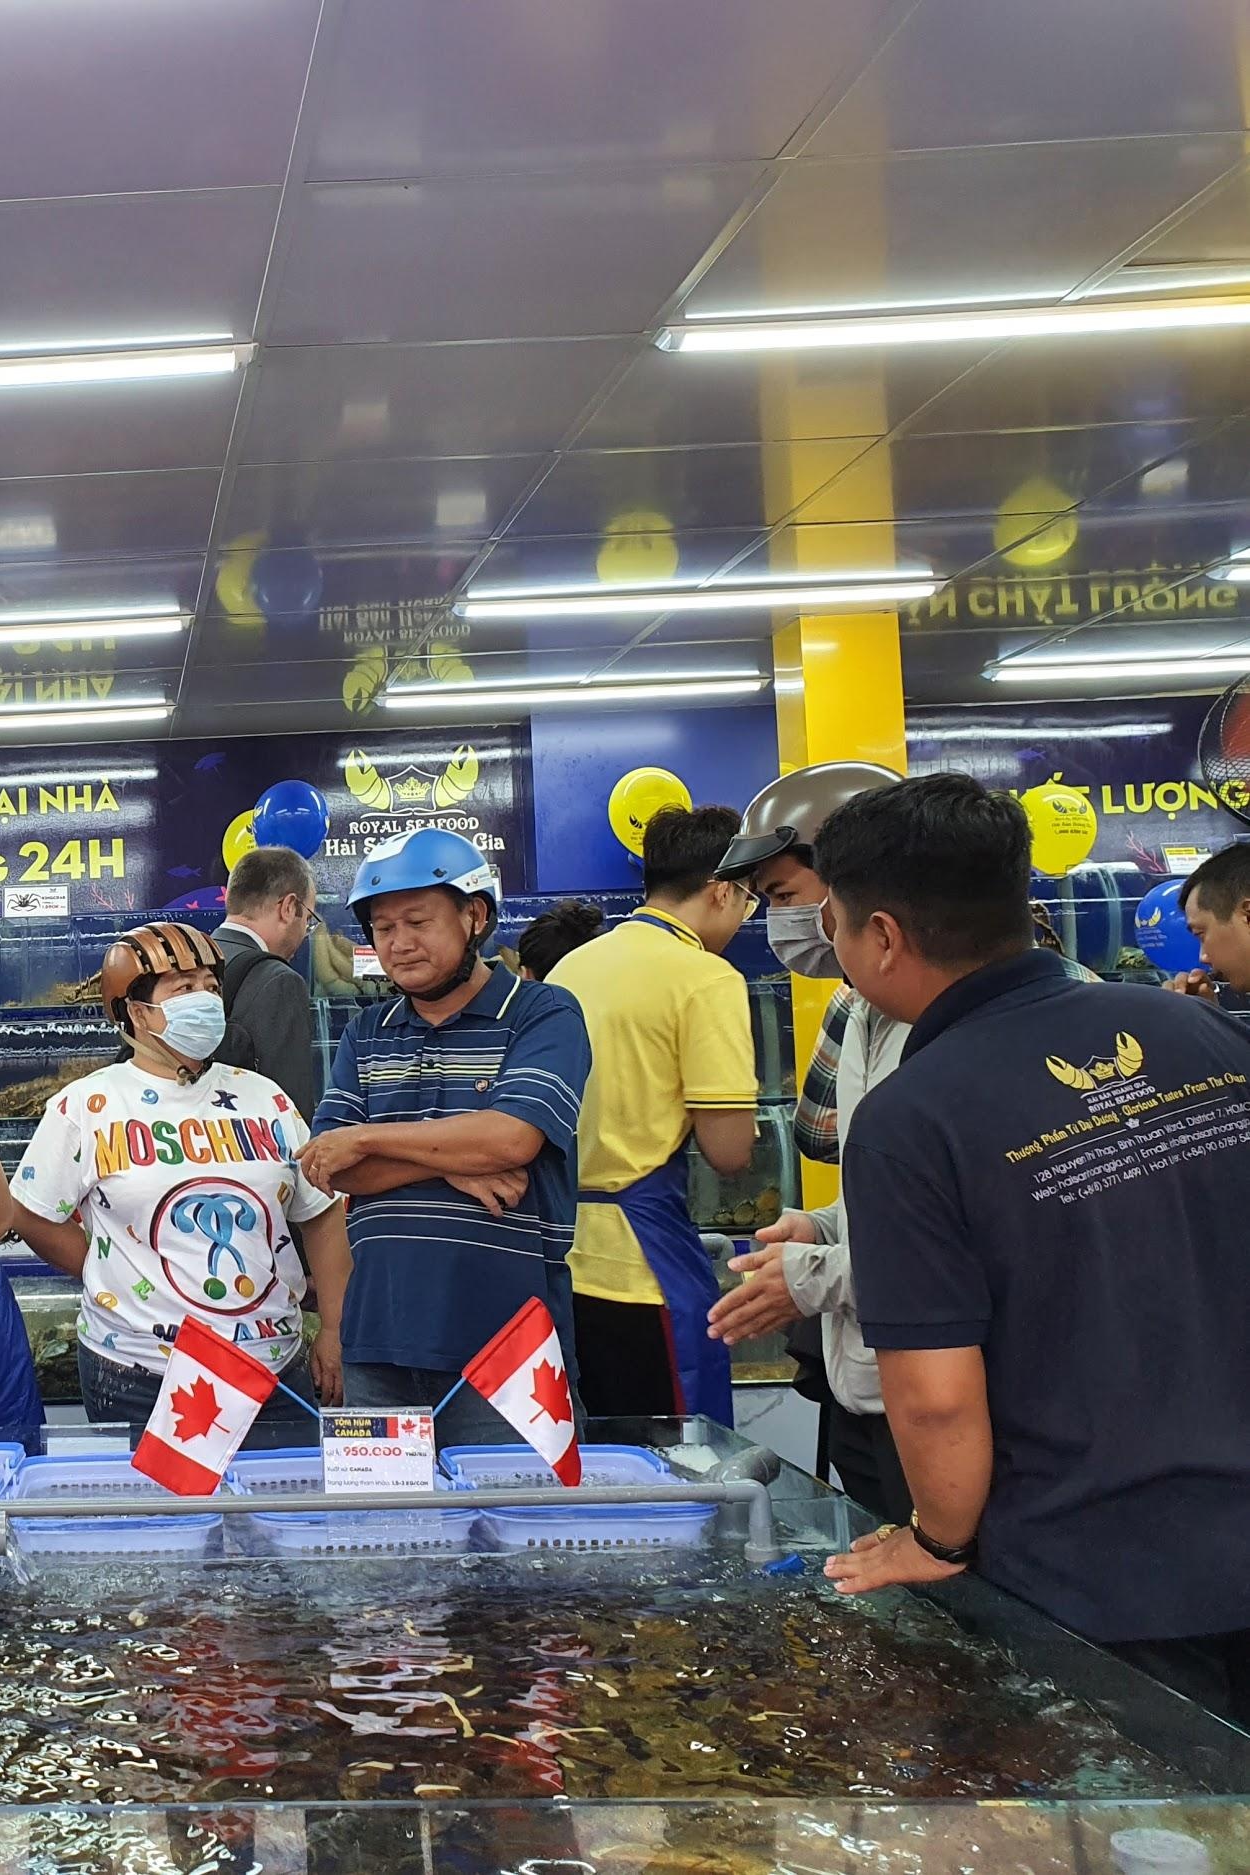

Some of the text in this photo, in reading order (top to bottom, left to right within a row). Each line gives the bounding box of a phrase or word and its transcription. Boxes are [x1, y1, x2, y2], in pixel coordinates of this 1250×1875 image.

[39, 777, 120, 814] NHÀ
[1101, 777, 1249, 821] LƯỢNG
[349, 820, 401, 835] ROYAL
[325, 837, 357, 857] Hải
[472, 832, 506, 851] Gia
[18, 838, 124, 883] 24H
[1088, 1085, 1156, 1114] ROYAL SEAFOOD
[1033, 1169, 1053, 1184] 128
[334, 1429, 372, 1437] CANADA
[343, 1446, 402, 1457] 950.000
